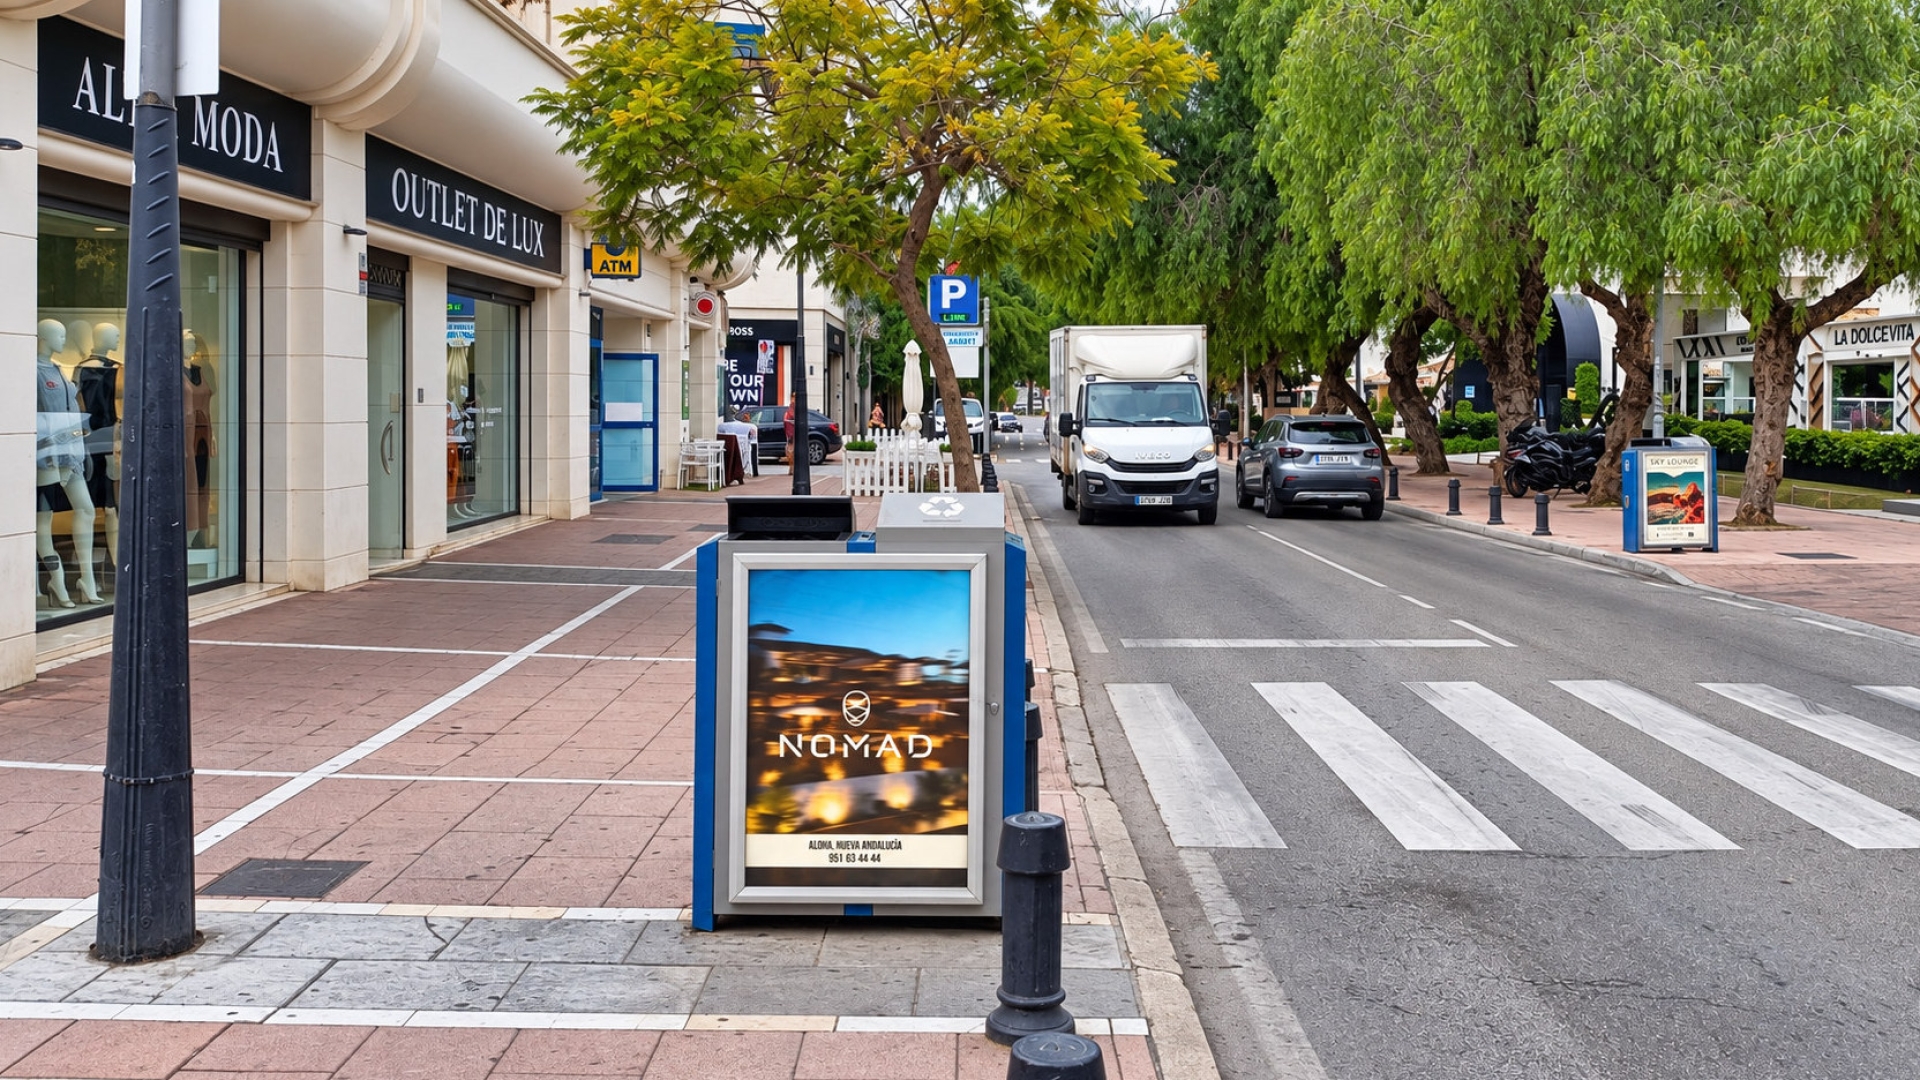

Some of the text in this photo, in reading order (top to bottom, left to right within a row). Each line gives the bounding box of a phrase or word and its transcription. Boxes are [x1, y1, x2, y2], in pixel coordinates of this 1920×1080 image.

[72, 56, 283, 172] AL MODA
[391, 167, 545, 258] OUTLET DE LUX
[600, 259, 632, 273] ATM
[941, 279, 967, 309] P
[1834, 322, 1915, 345] LA DOLCEVITA
[728, 374, 764, 387] OUR
[729, 389, 758, 402] WN
[1135, 451, 1171, 460] IVECO
[779, 733, 933, 758] NOMAD
[858, 853, 869, 863] 44
[870, 853, 881, 863] 44
